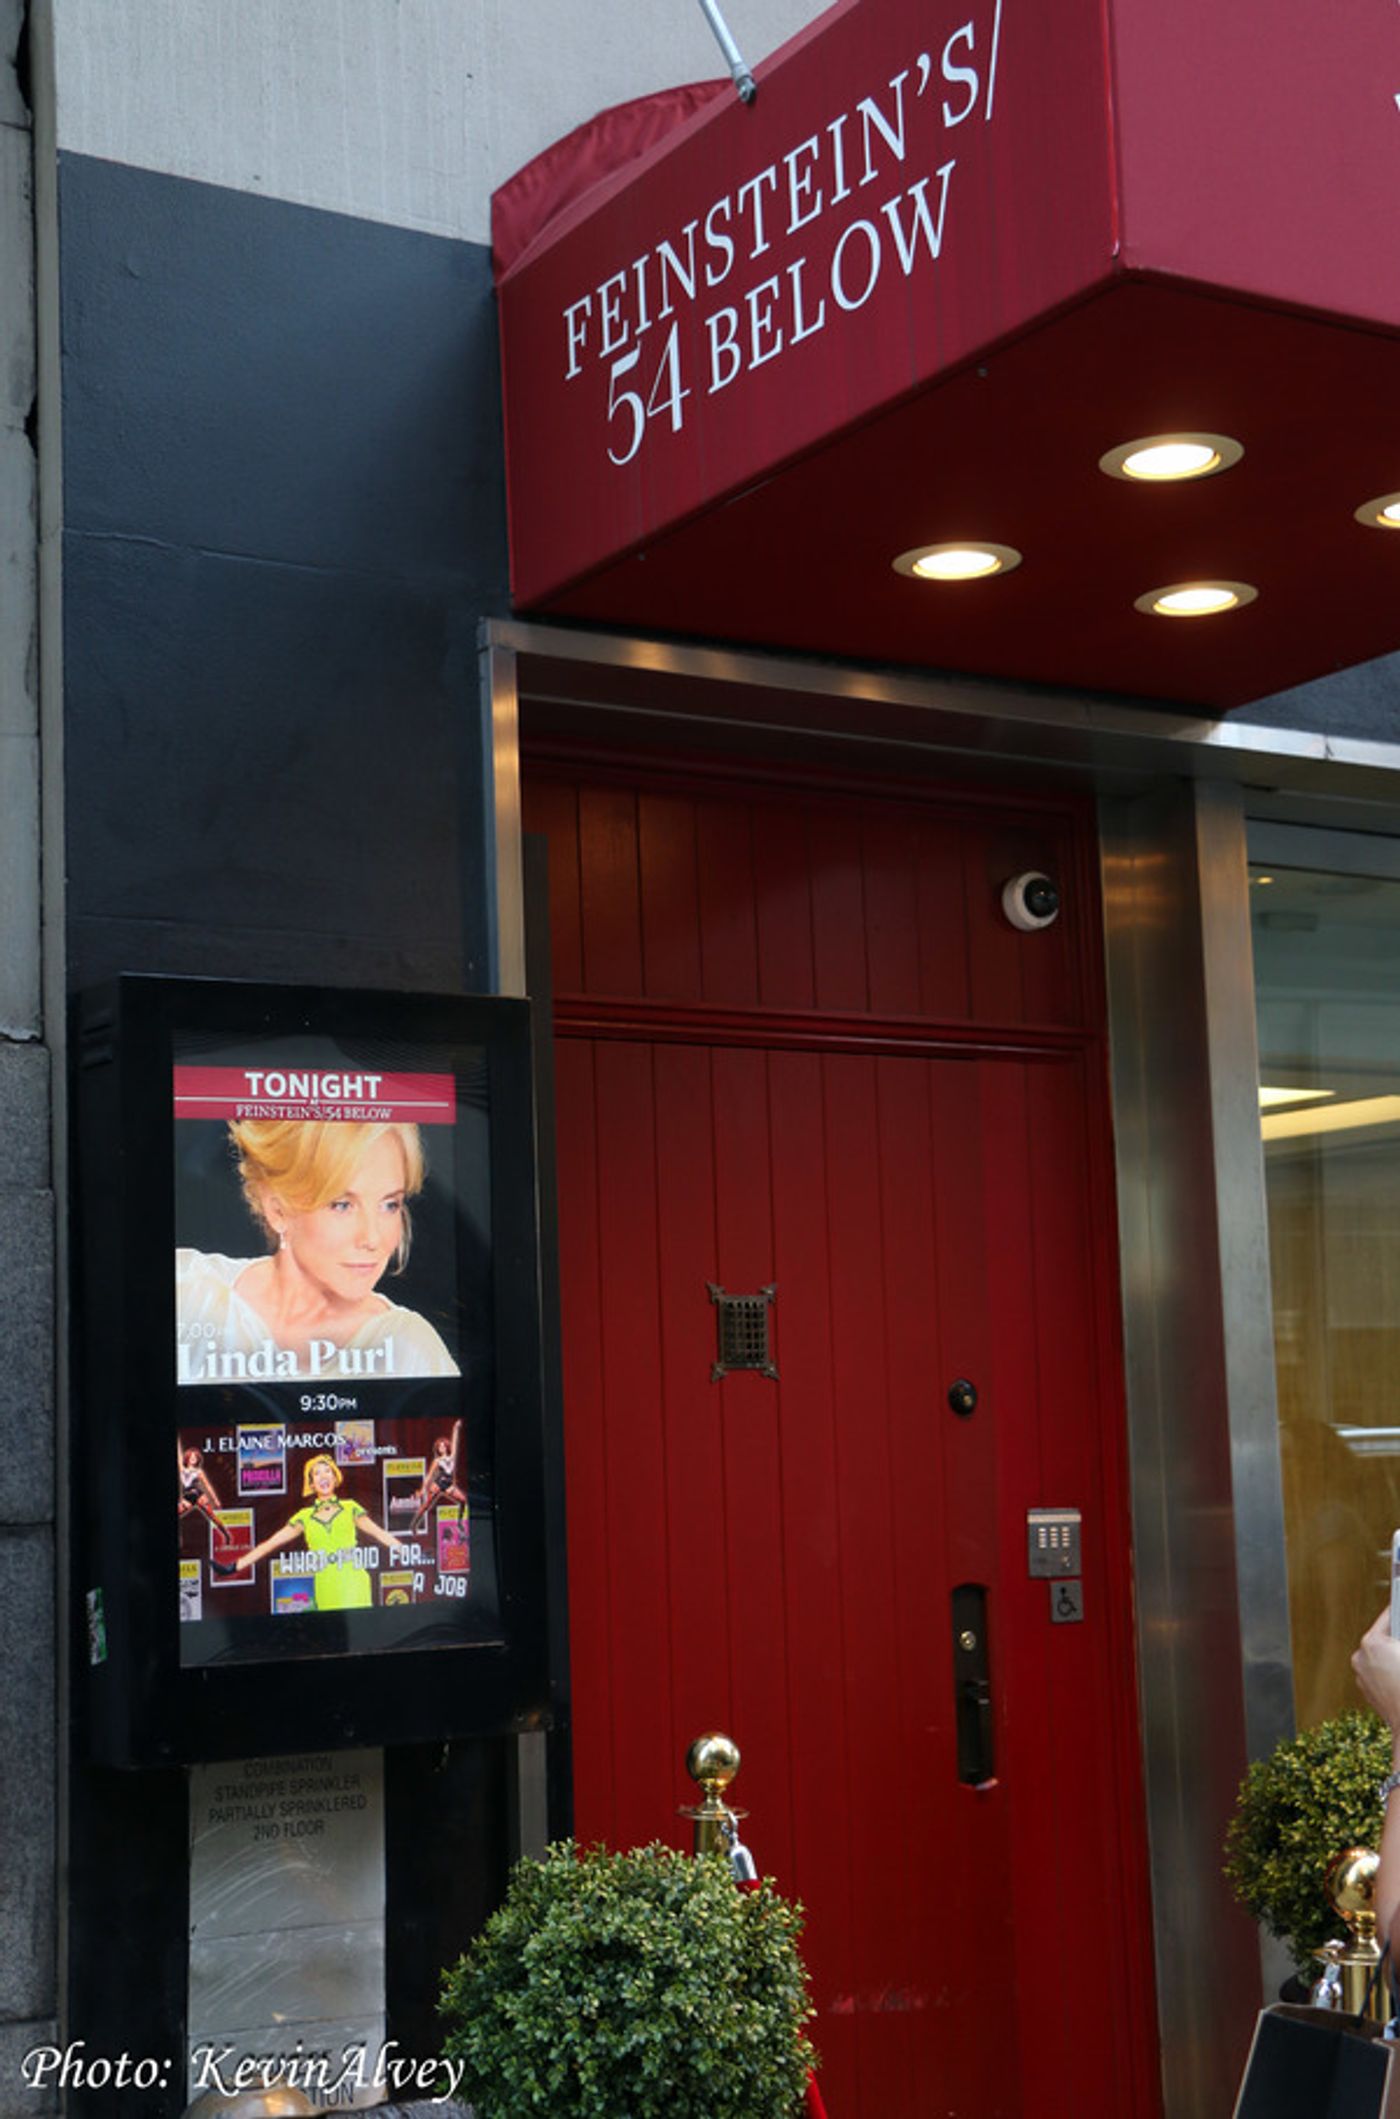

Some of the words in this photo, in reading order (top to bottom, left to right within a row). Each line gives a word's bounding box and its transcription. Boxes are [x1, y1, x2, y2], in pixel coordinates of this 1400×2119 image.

[606, 320, 690, 466] 54
[704, 160, 956, 395] BELOW
[244, 1072, 382, 1099] TONIGHT
[344, 1107, 393, 1120] BELOW
[177, 1338, 300, 1379] Linda
[309, 1336, 394, 1377] Purl
[277, 1432, 346, 1448] MARCOS
[434, 1575, 467, 1597] JOB
[244, 1756, 333, 1777] COMBINATION
[214, 1780, 285, 1802] STANDPIPE
[289, 1774, 361, 1796] SPRINKLER
[208, 1801, 276, 1824] PARTIALLY
[279, 1794, 367, 1818] SPRINKLERED
[284, 1819, 325, 1837] FLOOR
